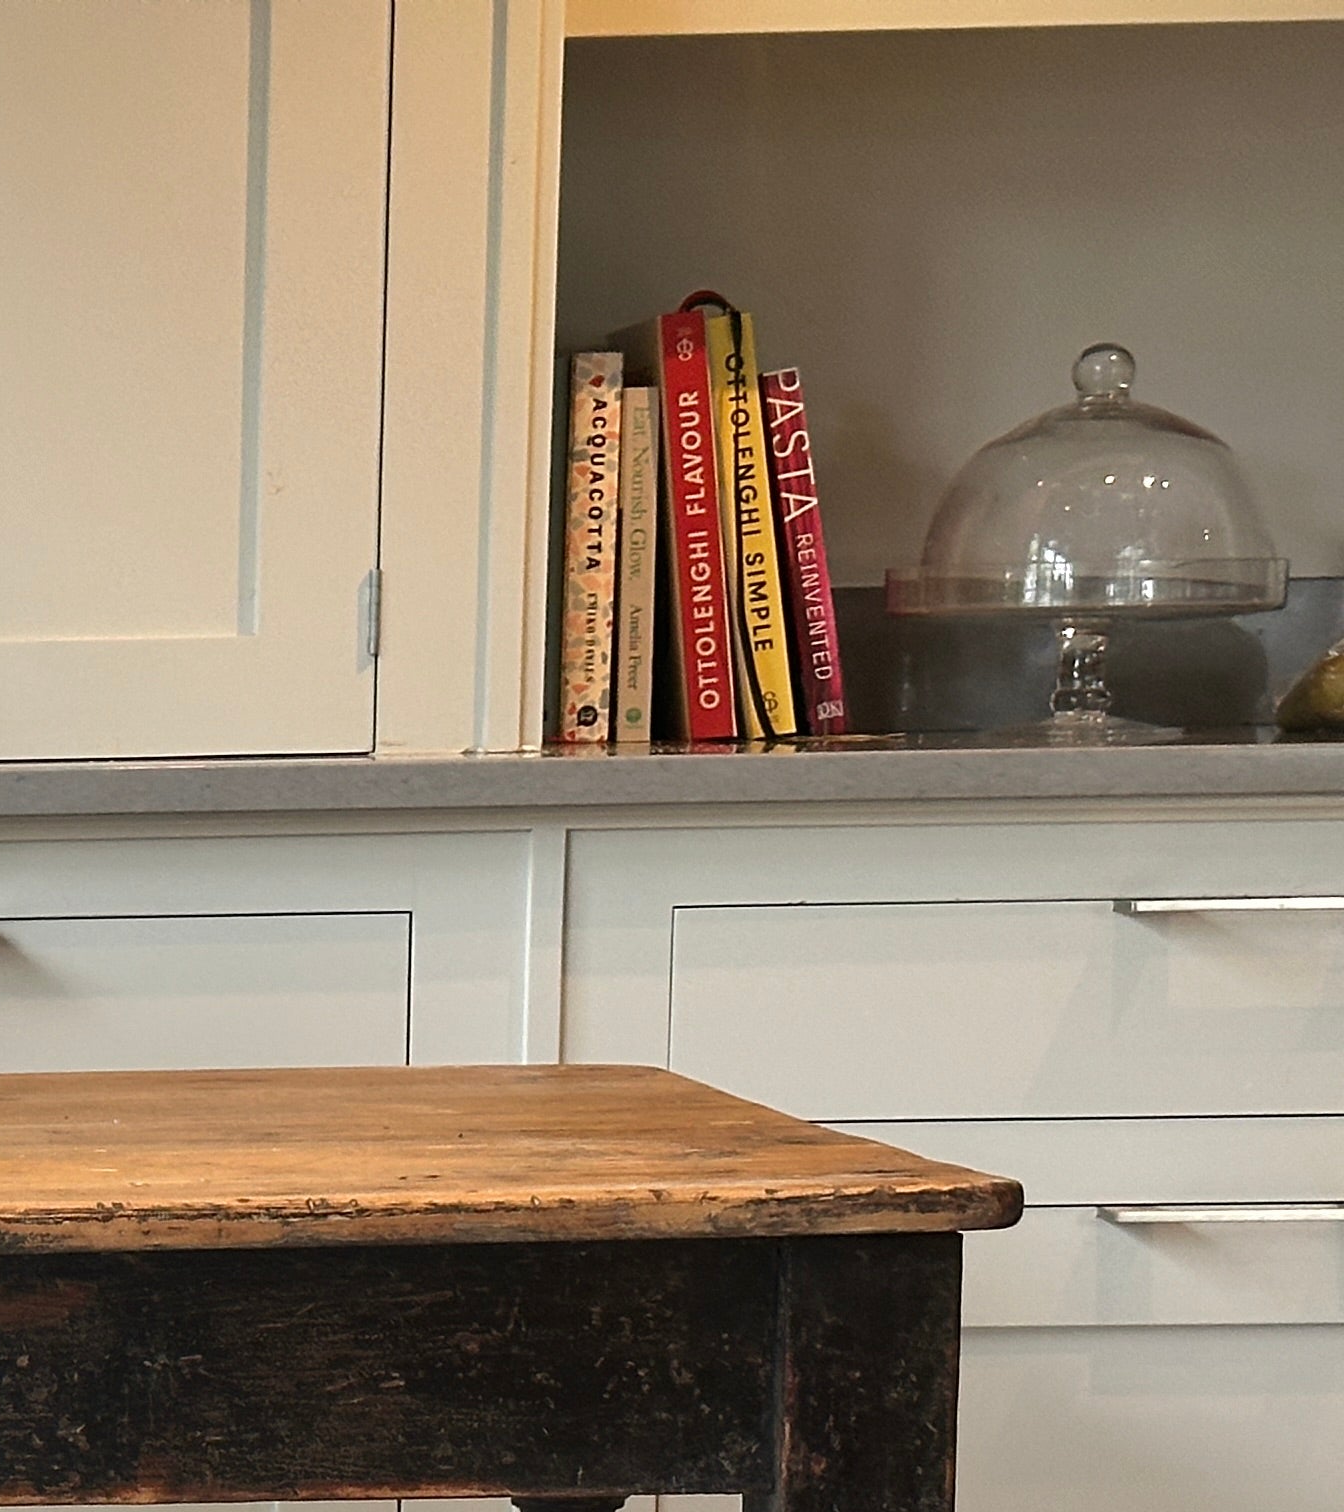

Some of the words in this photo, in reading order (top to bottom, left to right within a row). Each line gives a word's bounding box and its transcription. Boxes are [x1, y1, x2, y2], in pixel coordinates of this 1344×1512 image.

[586, 398, 608, 570] ACQUACOTTA
[679, 390, 707, 516] FLAVOUR
[725, 353, 762, 537] OTTOLENGHI
[745, 552, 774, 652] SIMPLE
[763, 367, 818, 523] PASTA
[796, 533, 833, 680] REINVENTED
[626, 655, 643, 691] Freer
[628, 603, 643, 652] Amelia
[687, 530, 720, 710] OTTOLENGHI
